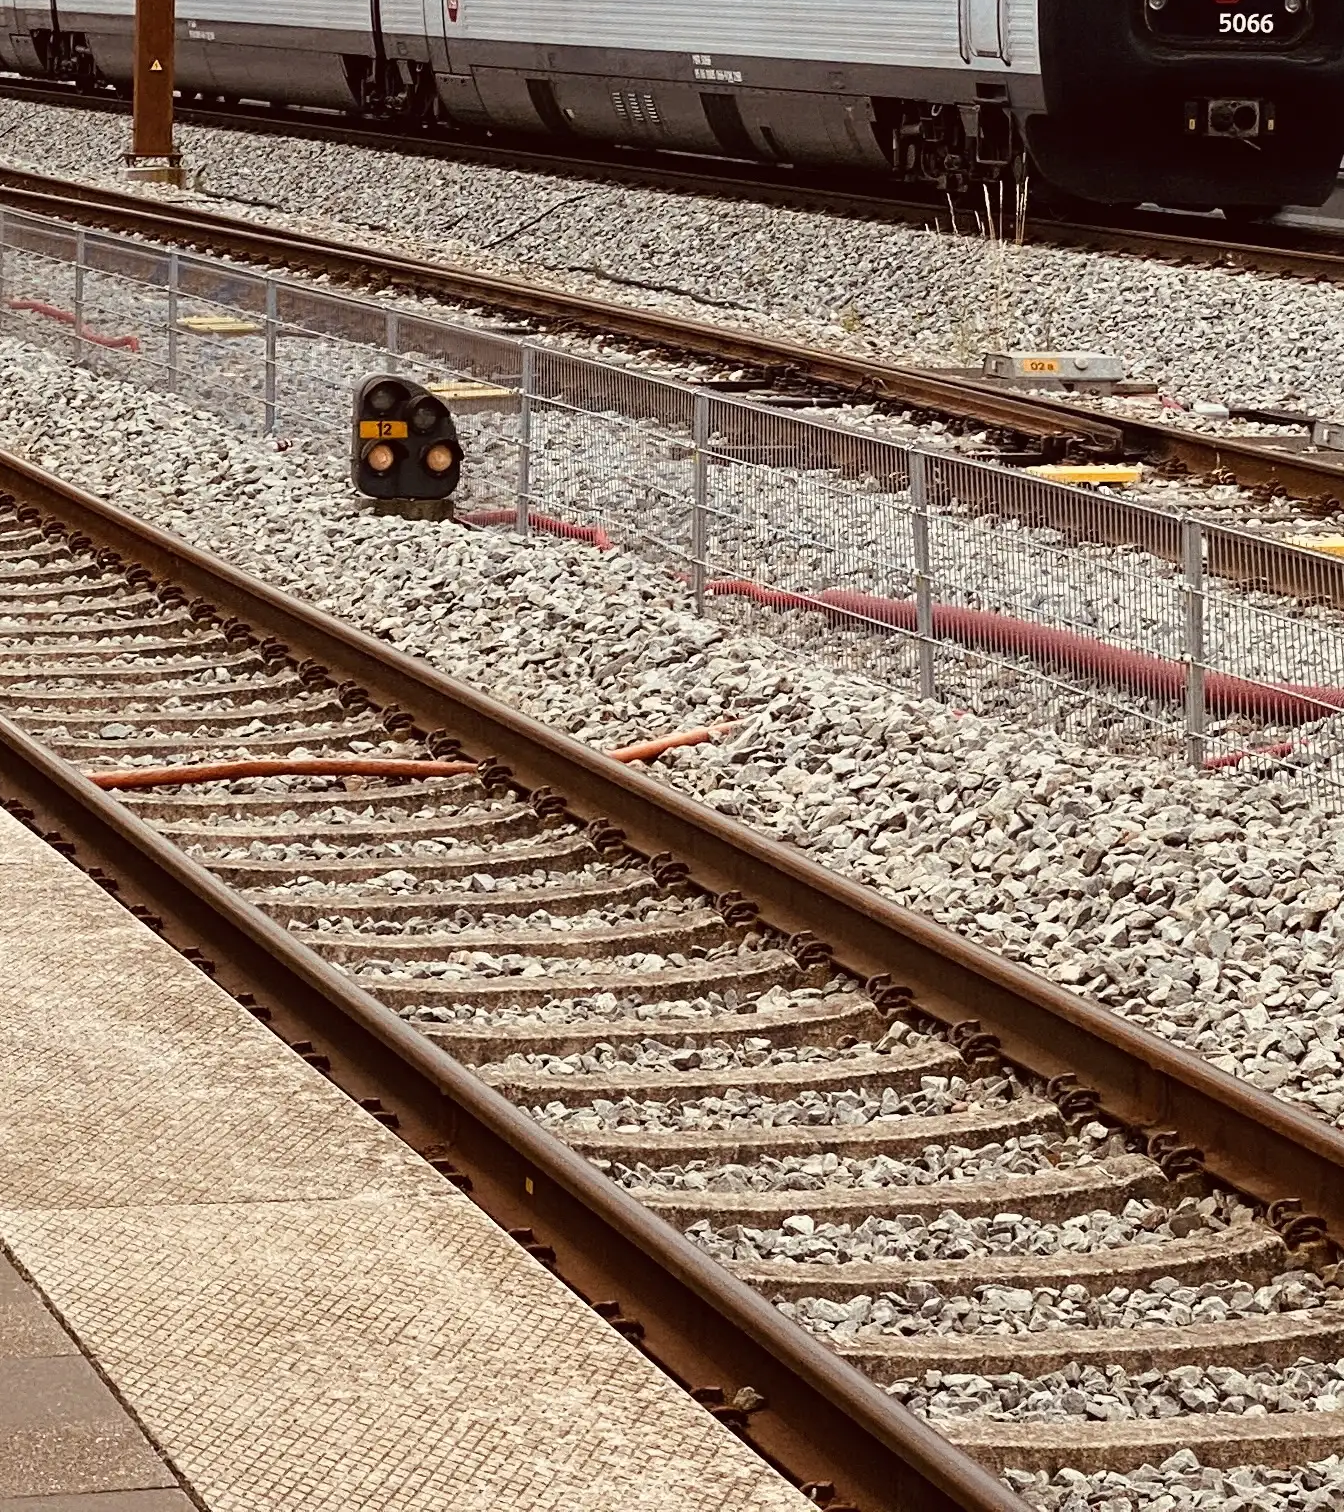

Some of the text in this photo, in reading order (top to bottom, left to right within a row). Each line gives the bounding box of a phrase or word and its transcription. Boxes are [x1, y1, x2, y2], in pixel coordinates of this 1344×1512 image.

[1218, 13, 1274, 34] 5066
[1030, 362, 1045, 371] 02
[376, 421, 392, 437] 12
